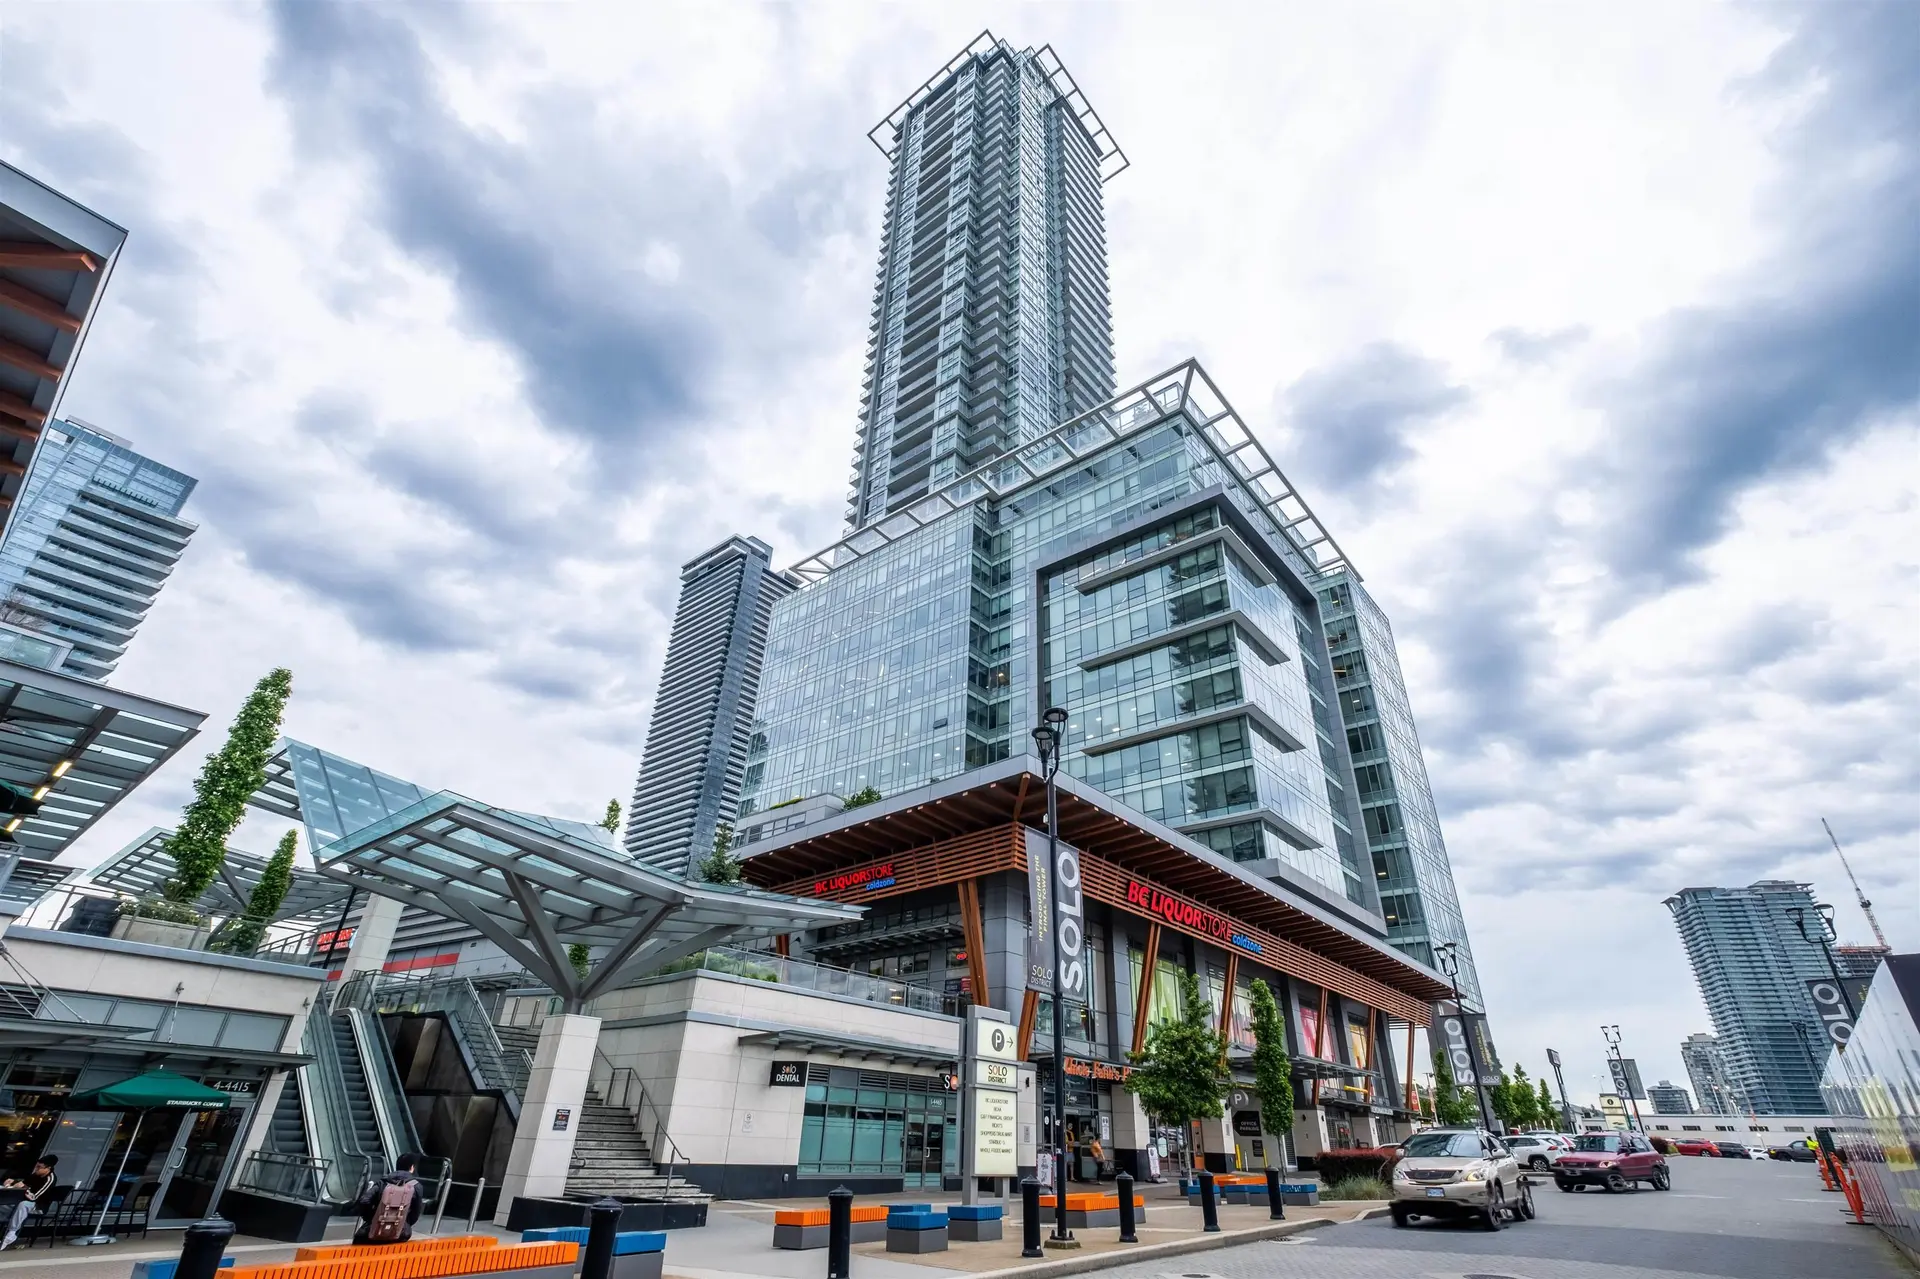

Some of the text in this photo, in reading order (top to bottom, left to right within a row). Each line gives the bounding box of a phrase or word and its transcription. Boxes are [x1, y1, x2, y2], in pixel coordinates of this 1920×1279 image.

[814, 881, 828, 894] BC
[865, 878, 896, 891] coldzone
[1127, 881, 1150, 907] BC
[1057, 851, 1083, 992] SOLO
[1232, 934, 1264, 954] coldzone
[1032, 964, 1053, 980] SOLO
[1813, 983, 1854, 1043] OLO
[1444, 1018, 1475, 1083] SOLO
[776, 1074, 800, 1082] DENTAL
[988, 1064, 1007, 1076] SOLO
[213, 1081, 250, 1092] 4-4415
[1610, 1061, 1629, 1098] SOLO
[1234, 1093, 1242, 1105] P
